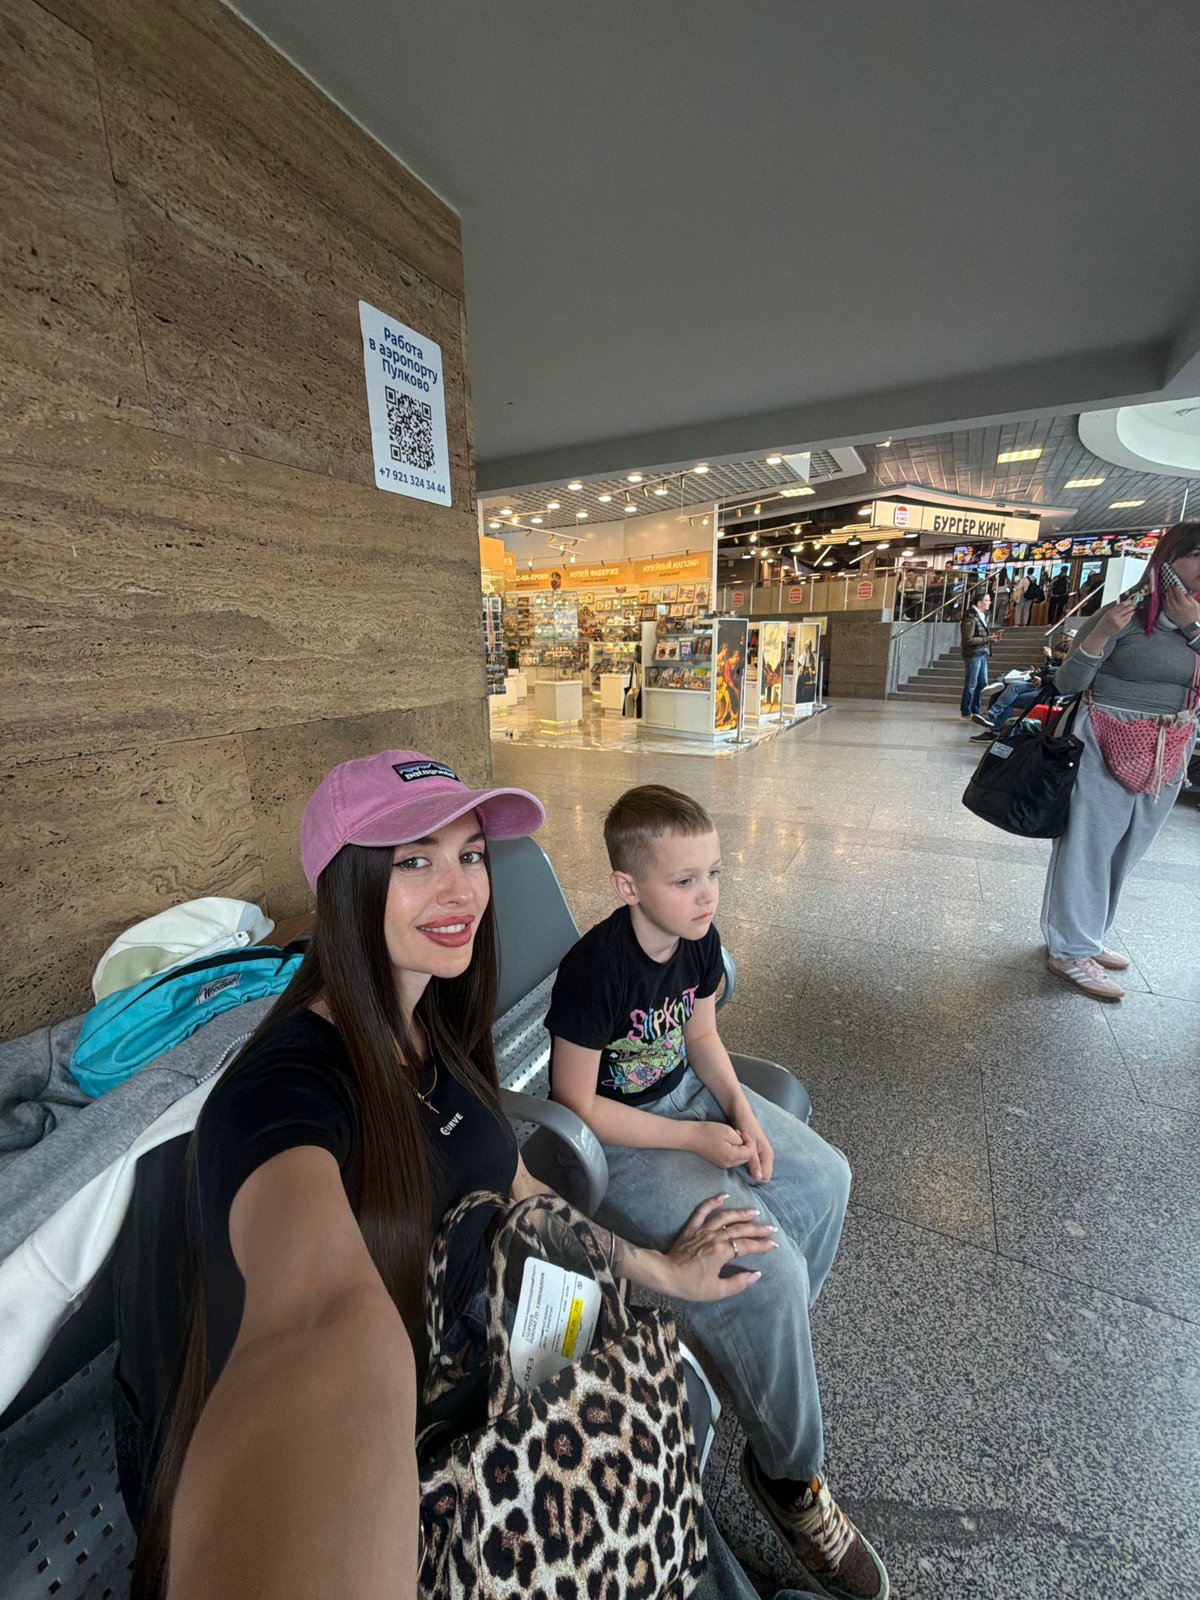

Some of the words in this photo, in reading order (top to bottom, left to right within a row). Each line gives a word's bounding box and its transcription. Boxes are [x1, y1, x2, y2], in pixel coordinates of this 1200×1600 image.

[384, 327, 423, 360] Работа
[380, 343, 438, 384] аэропорту
[382, 359, 429, 392] Пулково
[379, 467, 390, 478] +7
[393, 470, 408, 484] 921
[410, 475, 424, 488] 324
[426, 480, 435, 491] 34
[437, 485, 446, 494] 44
[933, 515, 976, 534] БУРГЕР
[978, 520, 1006, 538] КИНГ
[569, 569, 589, 578] МУЗЕЙ
[590, 568, 620, 576] ФАБЕРЖЕ
[440, 1112, 463, 1136] CURVE
